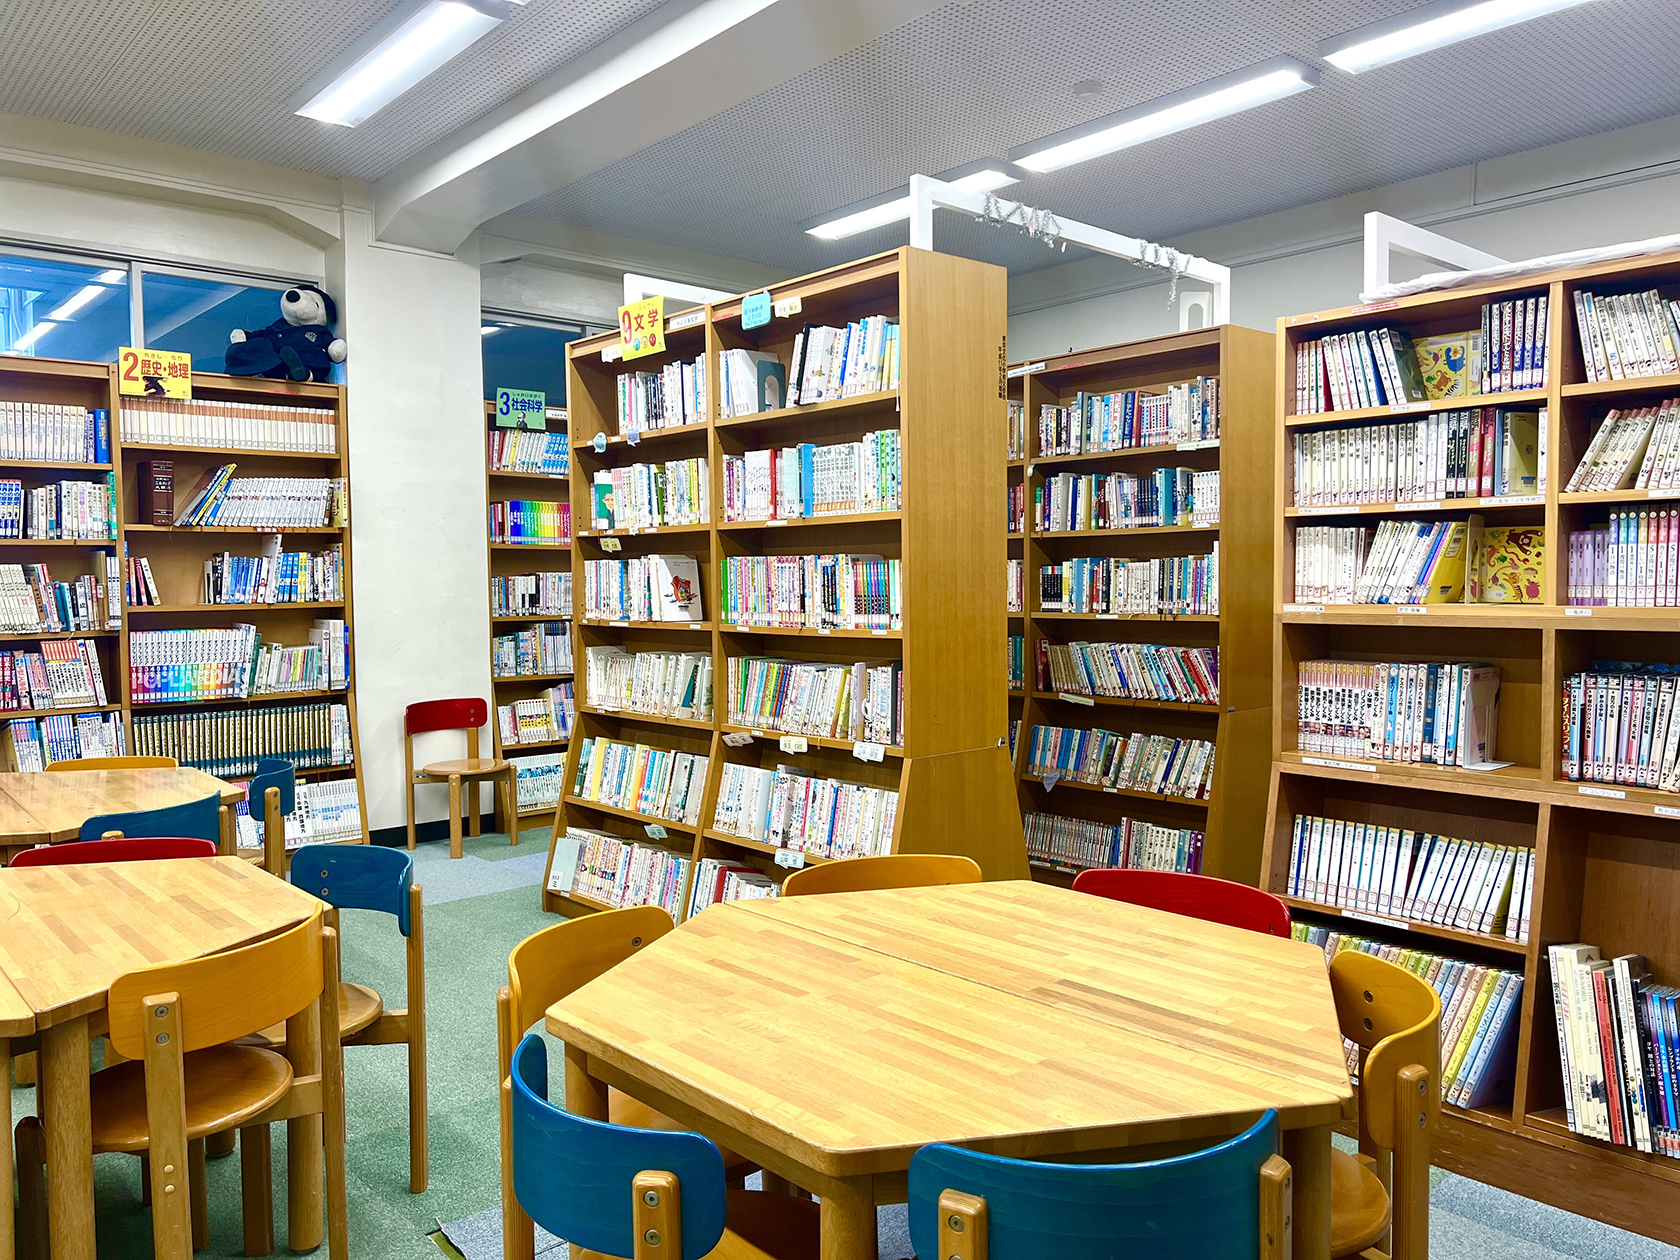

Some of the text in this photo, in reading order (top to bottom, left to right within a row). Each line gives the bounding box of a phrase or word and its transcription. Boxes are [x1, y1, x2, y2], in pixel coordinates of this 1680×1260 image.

[622, 308, 659, 344] 9 文学
[123, 352, 189, 381] 2 歴史・地理
[500, 392, 542, 415] 3 社会科学
